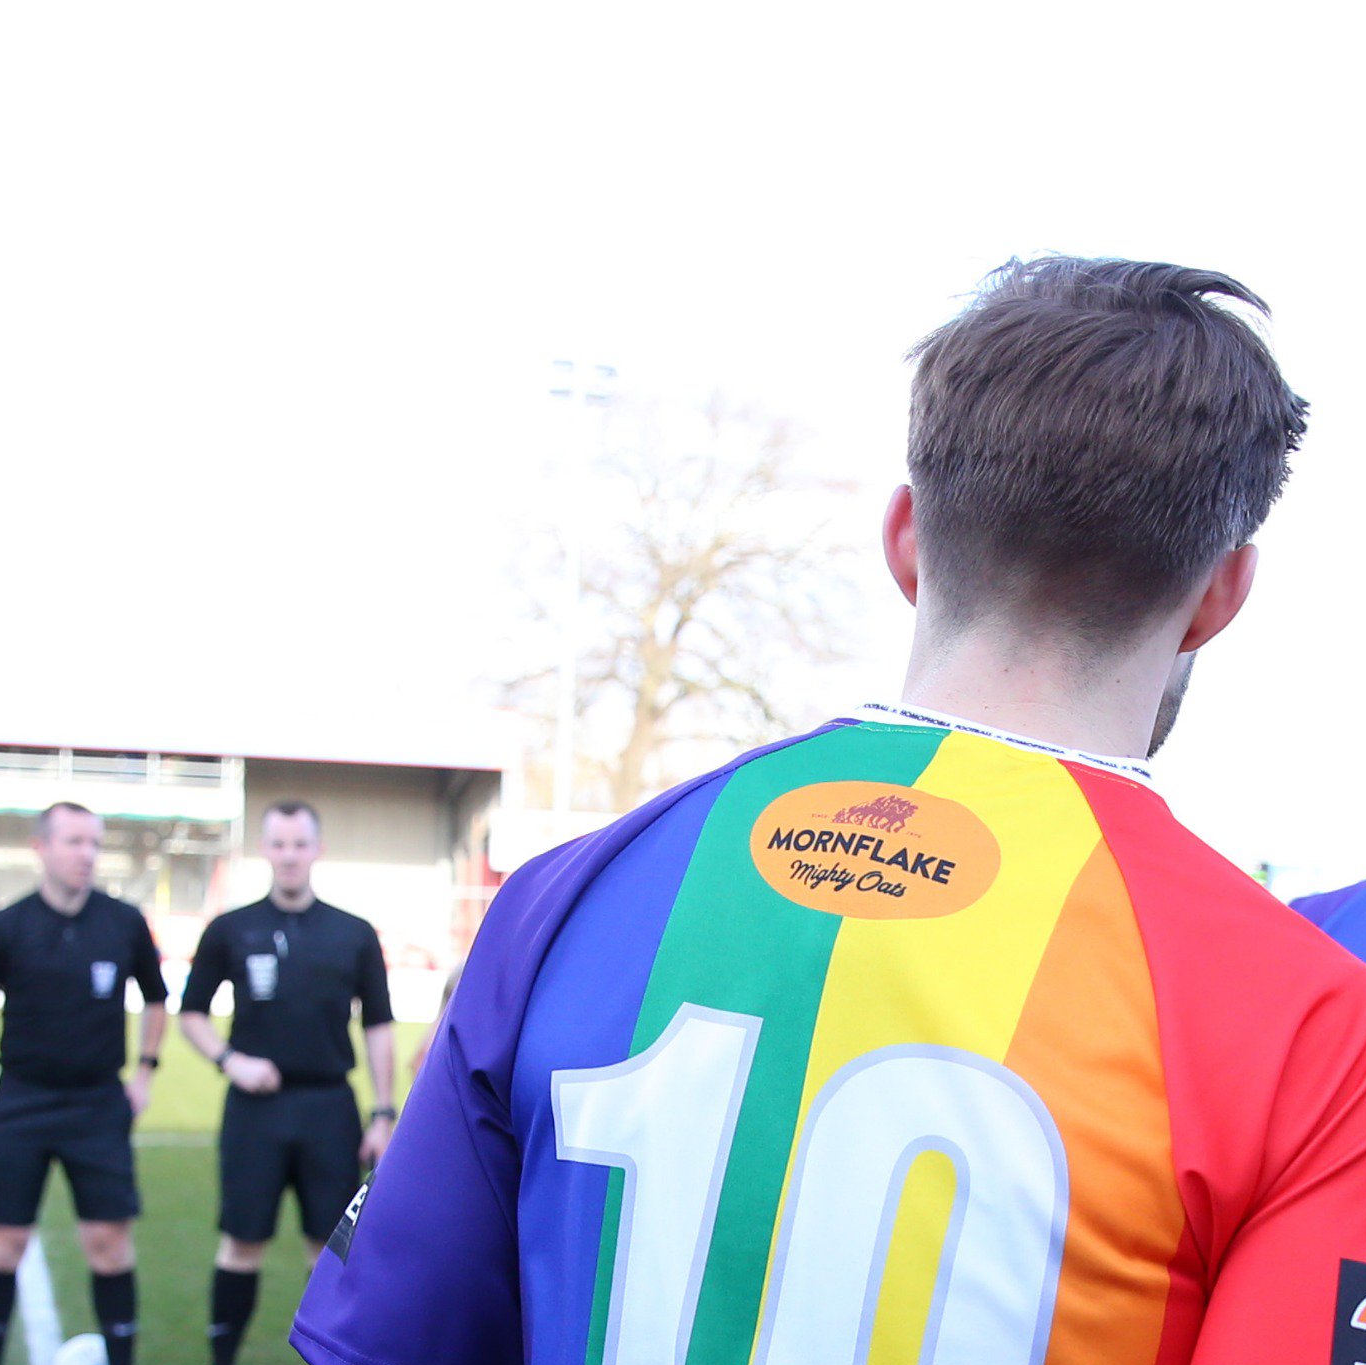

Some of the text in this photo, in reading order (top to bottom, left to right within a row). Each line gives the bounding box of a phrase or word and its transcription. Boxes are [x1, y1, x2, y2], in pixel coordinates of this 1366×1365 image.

[899, 709, 951, 728] HOMOPHOBIA
[767, 827, 956, 885] MORNFLAKE
[790, 859, 908, 898] Mighty Oats
